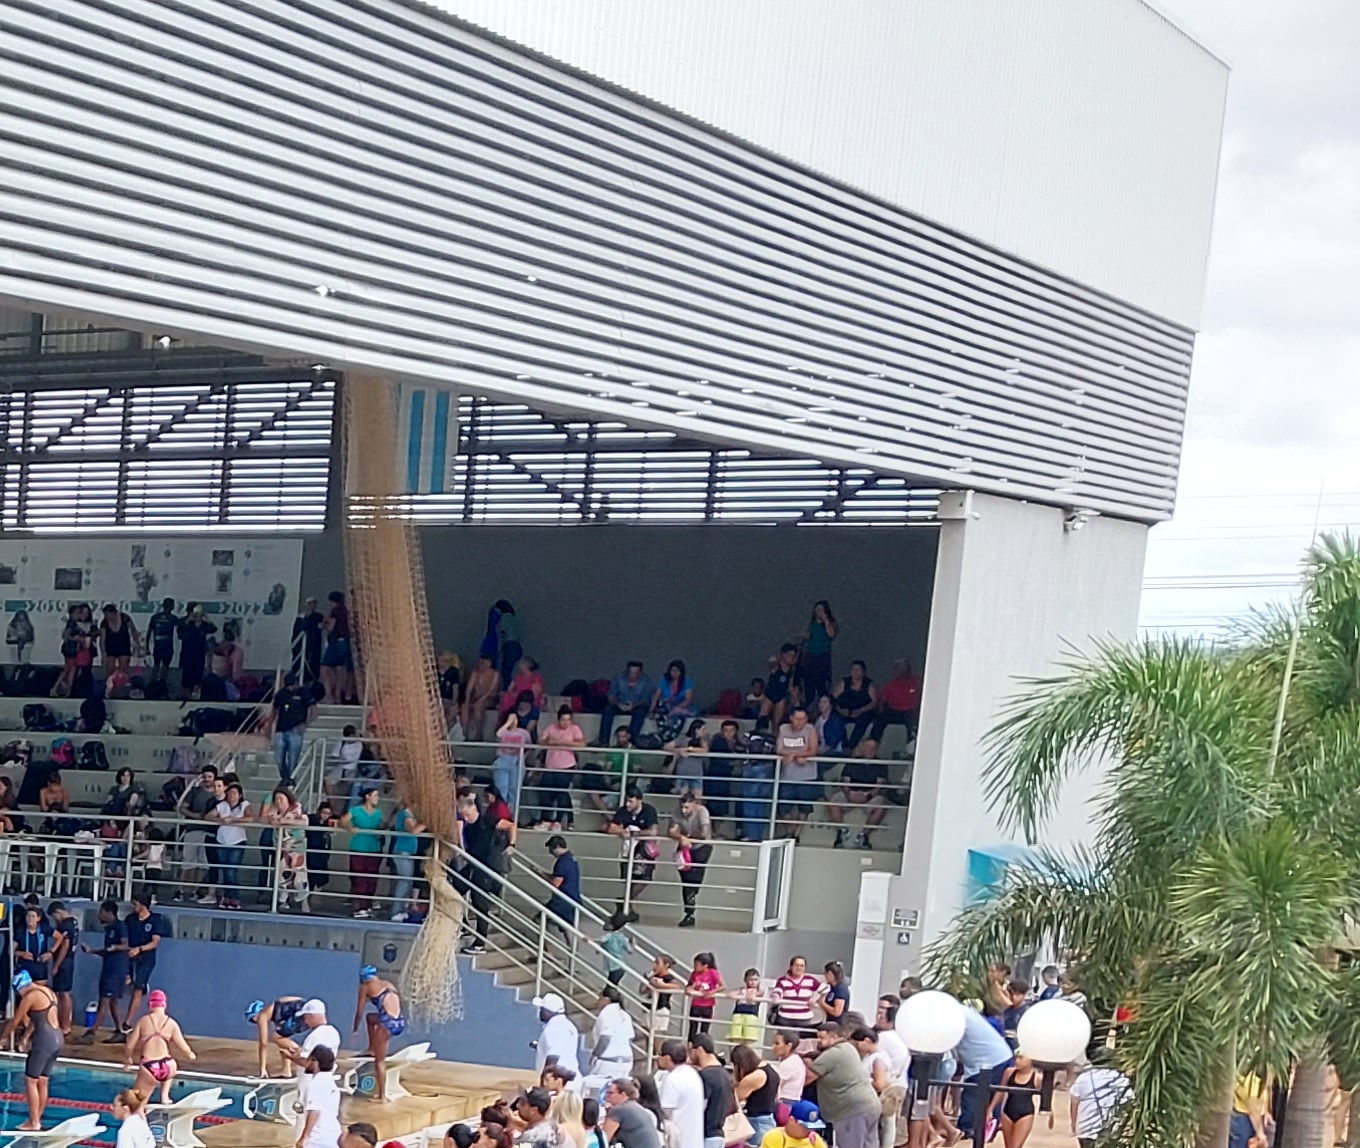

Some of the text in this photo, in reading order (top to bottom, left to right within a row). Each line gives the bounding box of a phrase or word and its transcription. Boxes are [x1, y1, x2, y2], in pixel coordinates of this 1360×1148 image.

[32, 600, 67, 612] 2019
[225, 602, 264, 614] 2022
[361, 1076, 376, 1091] 0
[262, 1098, 277, 1115] 1
